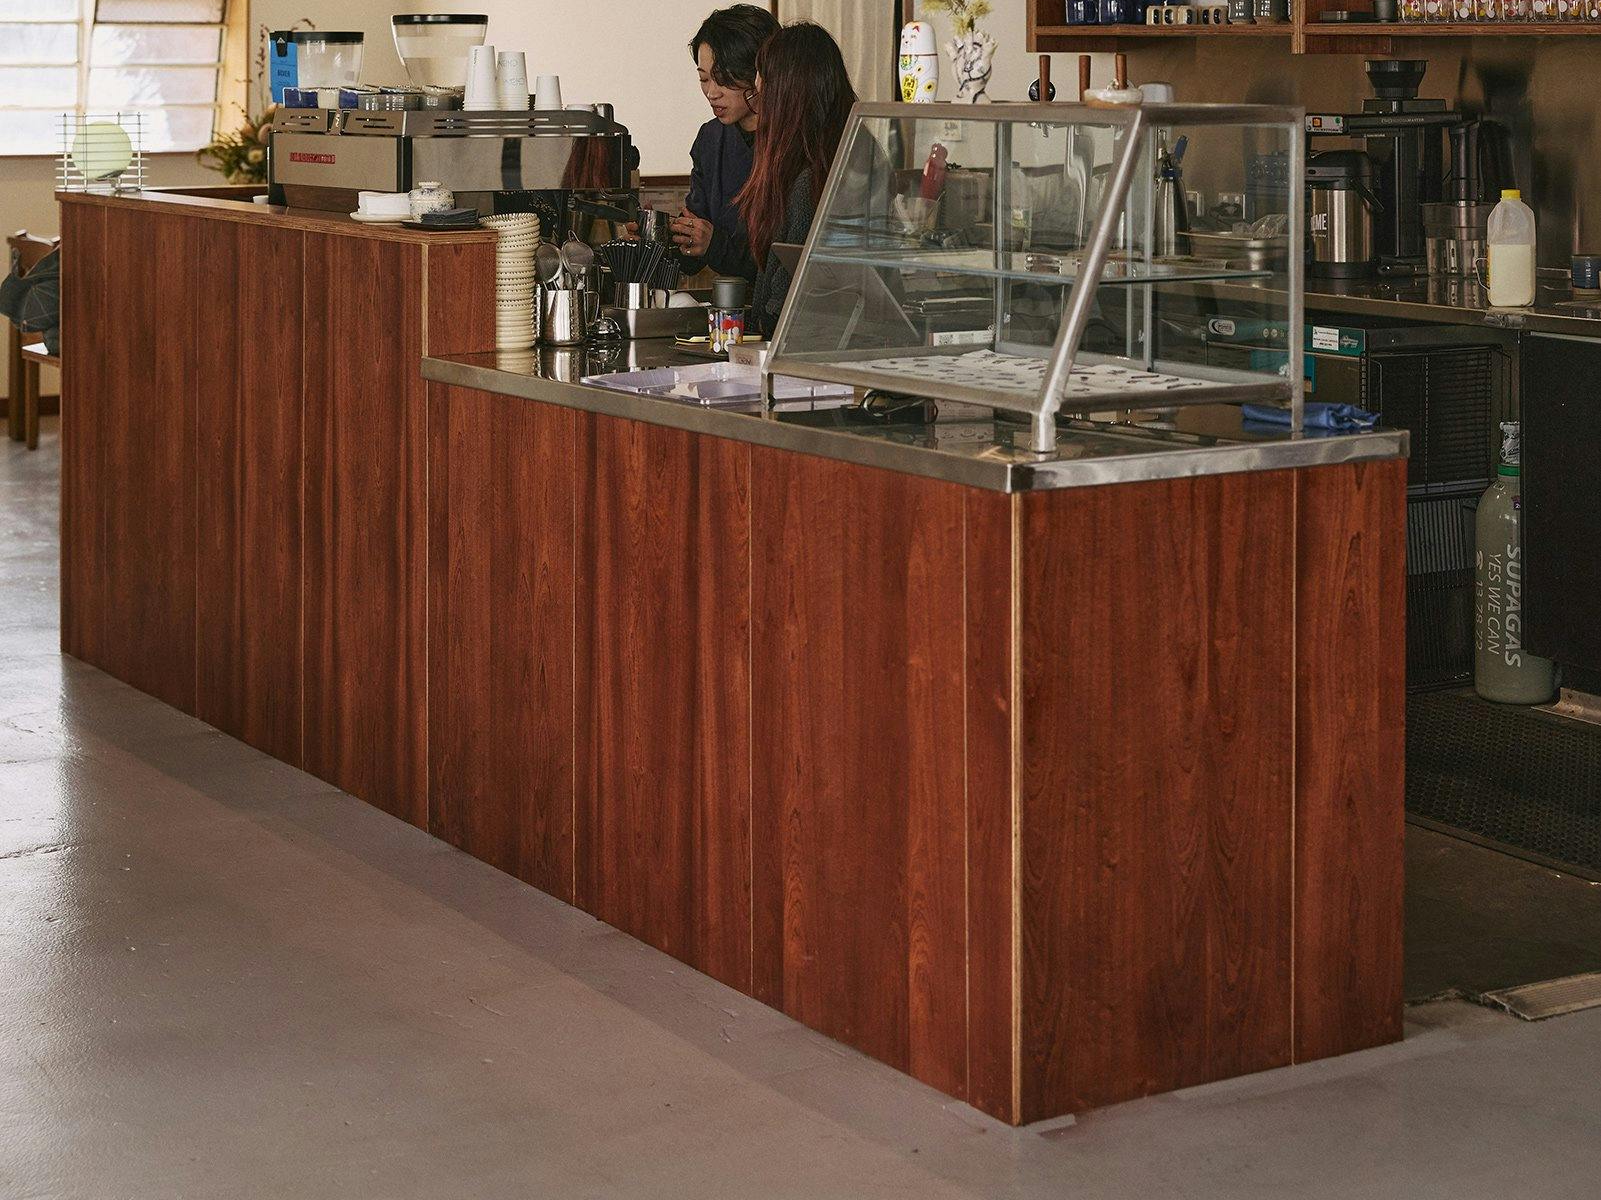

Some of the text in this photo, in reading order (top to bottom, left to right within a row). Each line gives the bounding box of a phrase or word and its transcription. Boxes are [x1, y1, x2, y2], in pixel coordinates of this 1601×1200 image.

[1487, 553, 1501, 655] YES WE CAN
[1505, 543, 1521, 668] SUPAGAS
